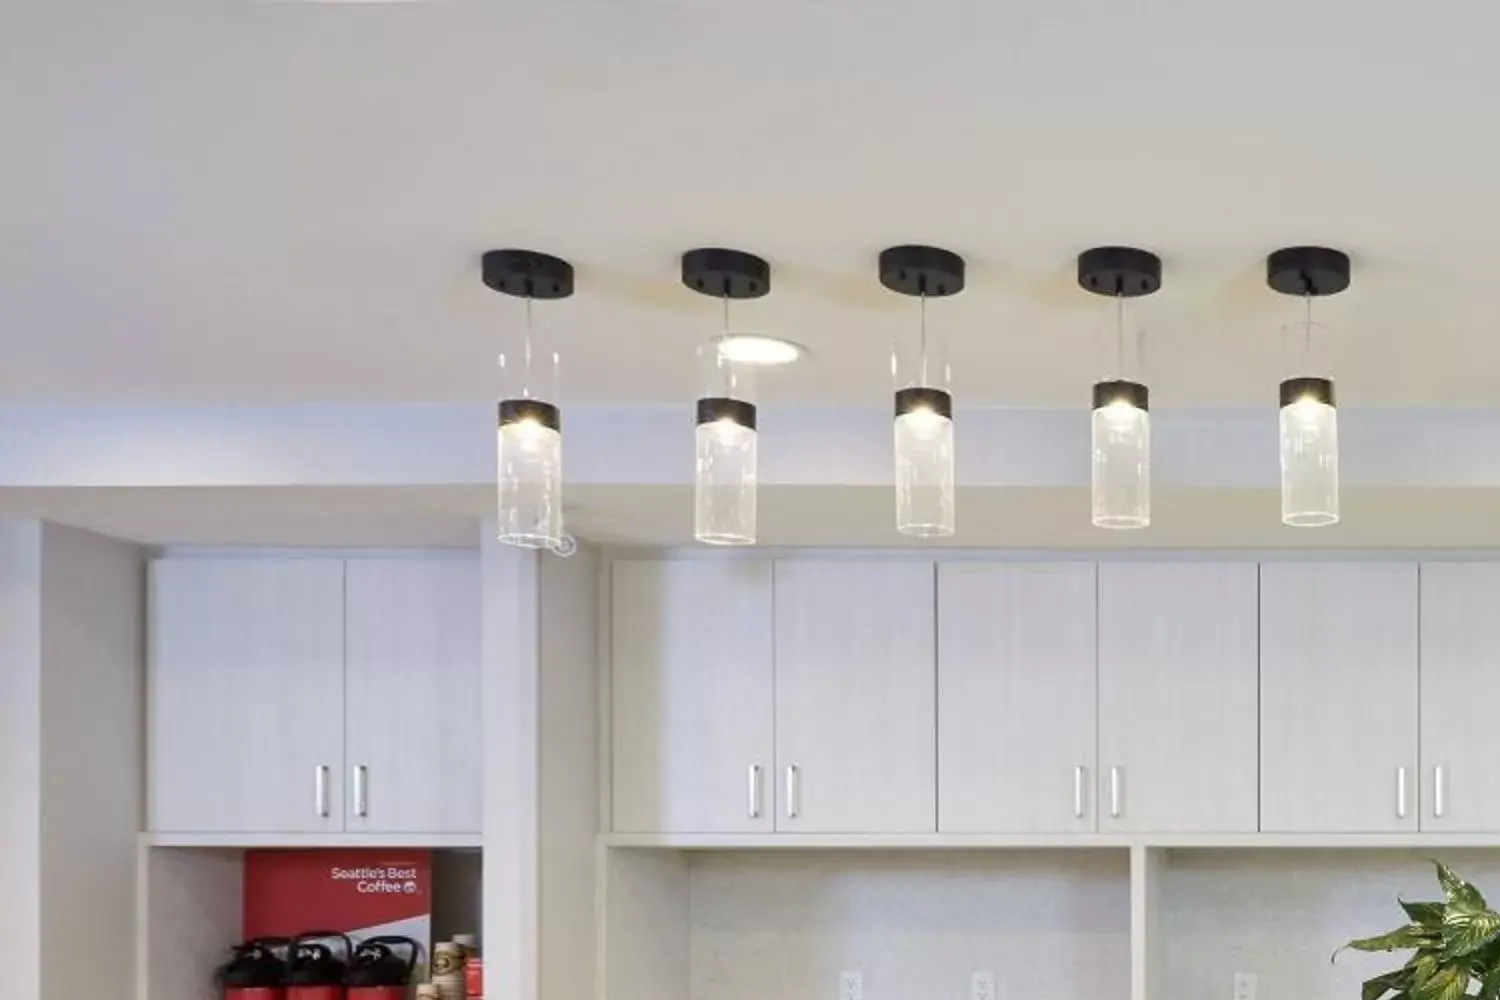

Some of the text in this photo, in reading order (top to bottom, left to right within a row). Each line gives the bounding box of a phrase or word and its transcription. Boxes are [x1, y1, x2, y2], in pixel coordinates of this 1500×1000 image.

[331, 867, 417, 879] Seattle's Best
[357, 881, 401, 893] Coffee
